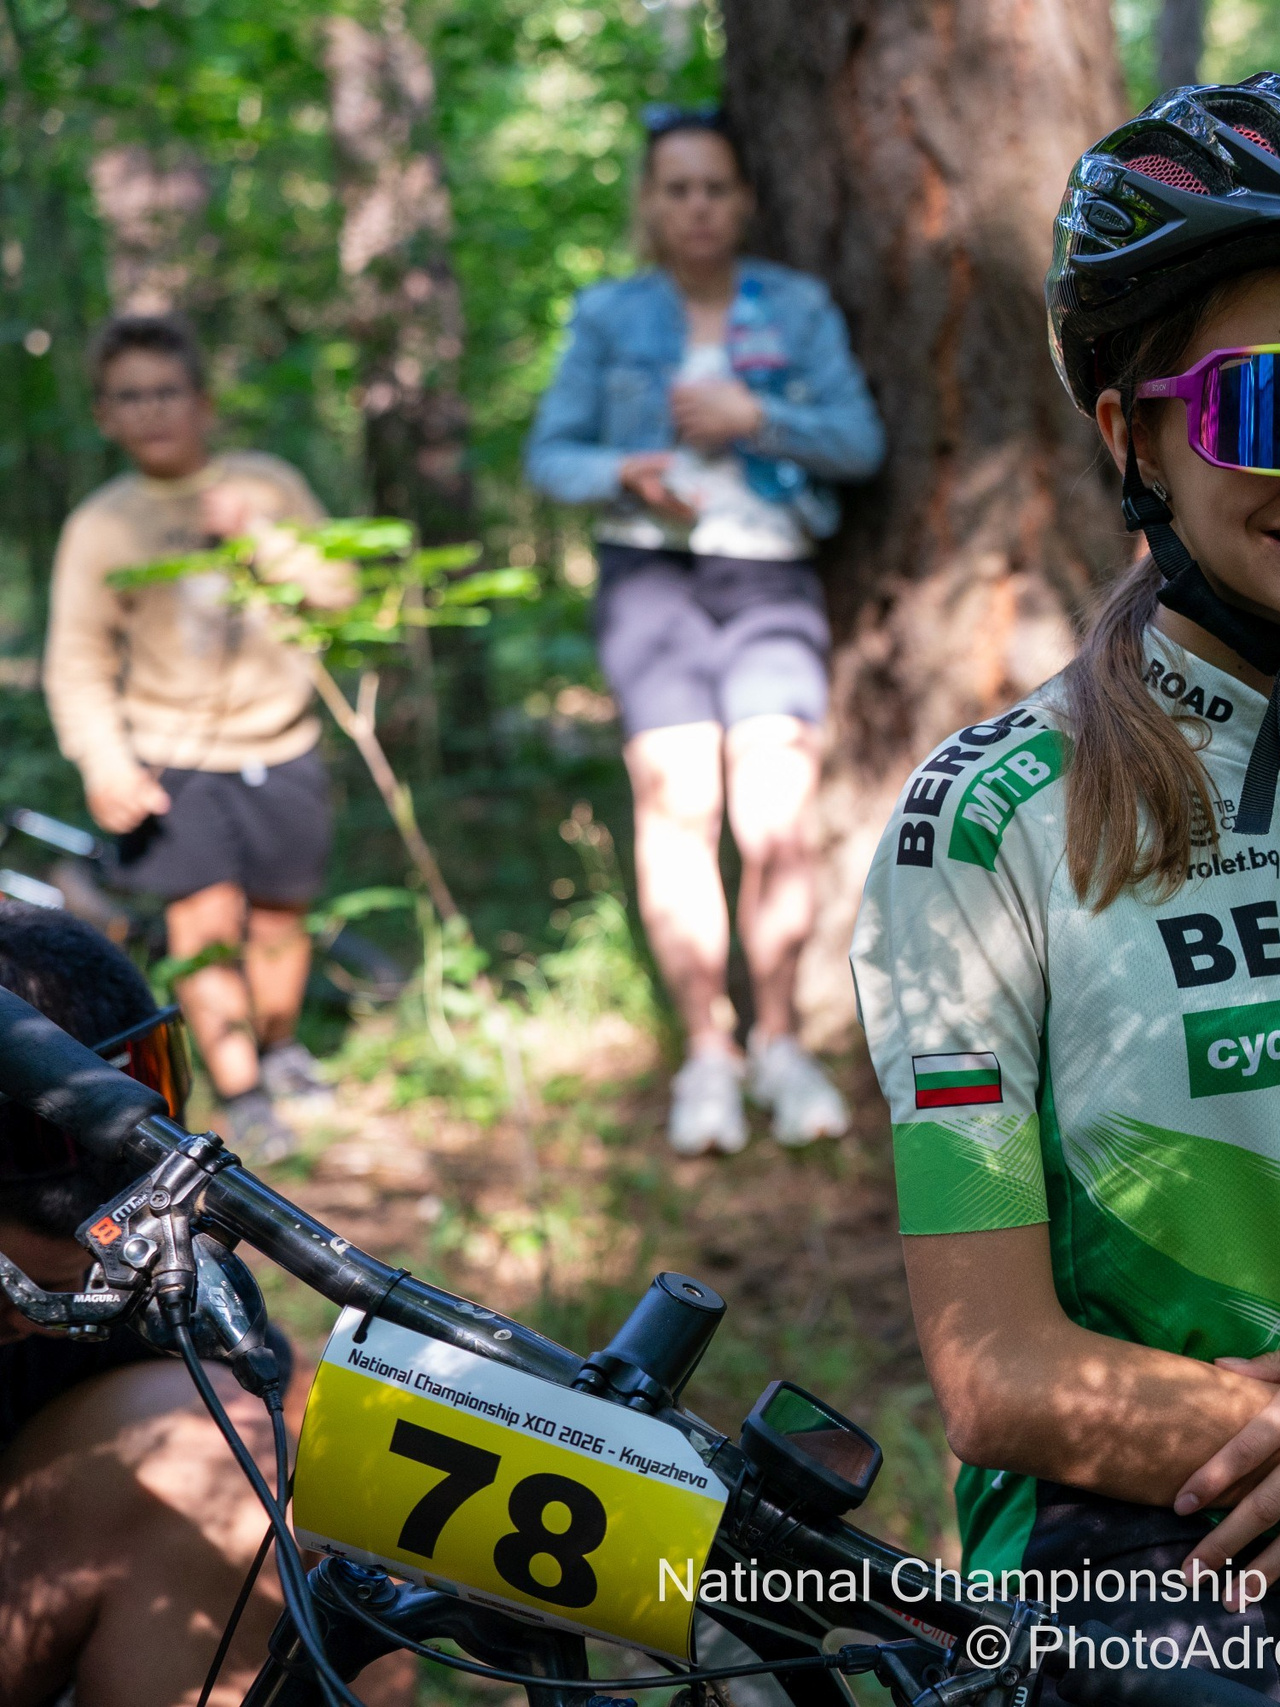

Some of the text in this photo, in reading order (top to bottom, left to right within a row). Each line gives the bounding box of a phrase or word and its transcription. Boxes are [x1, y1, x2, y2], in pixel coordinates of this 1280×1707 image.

[1145, 658, 1234, 723] ROAD
[961, 750, 1051, 836] MTB
[73, 1294, 121, 1303] MAGURA
[347, 1348, 414, 1385] National
[414, 1372, 521, 1427] Championship
[522, 1412, 557, 1438] XCO
[558, 1425, 606, 1455] 2026
[619, 1446, 708, 1490] Knyazhevo
[388, 1418, 608, 1609] 78
